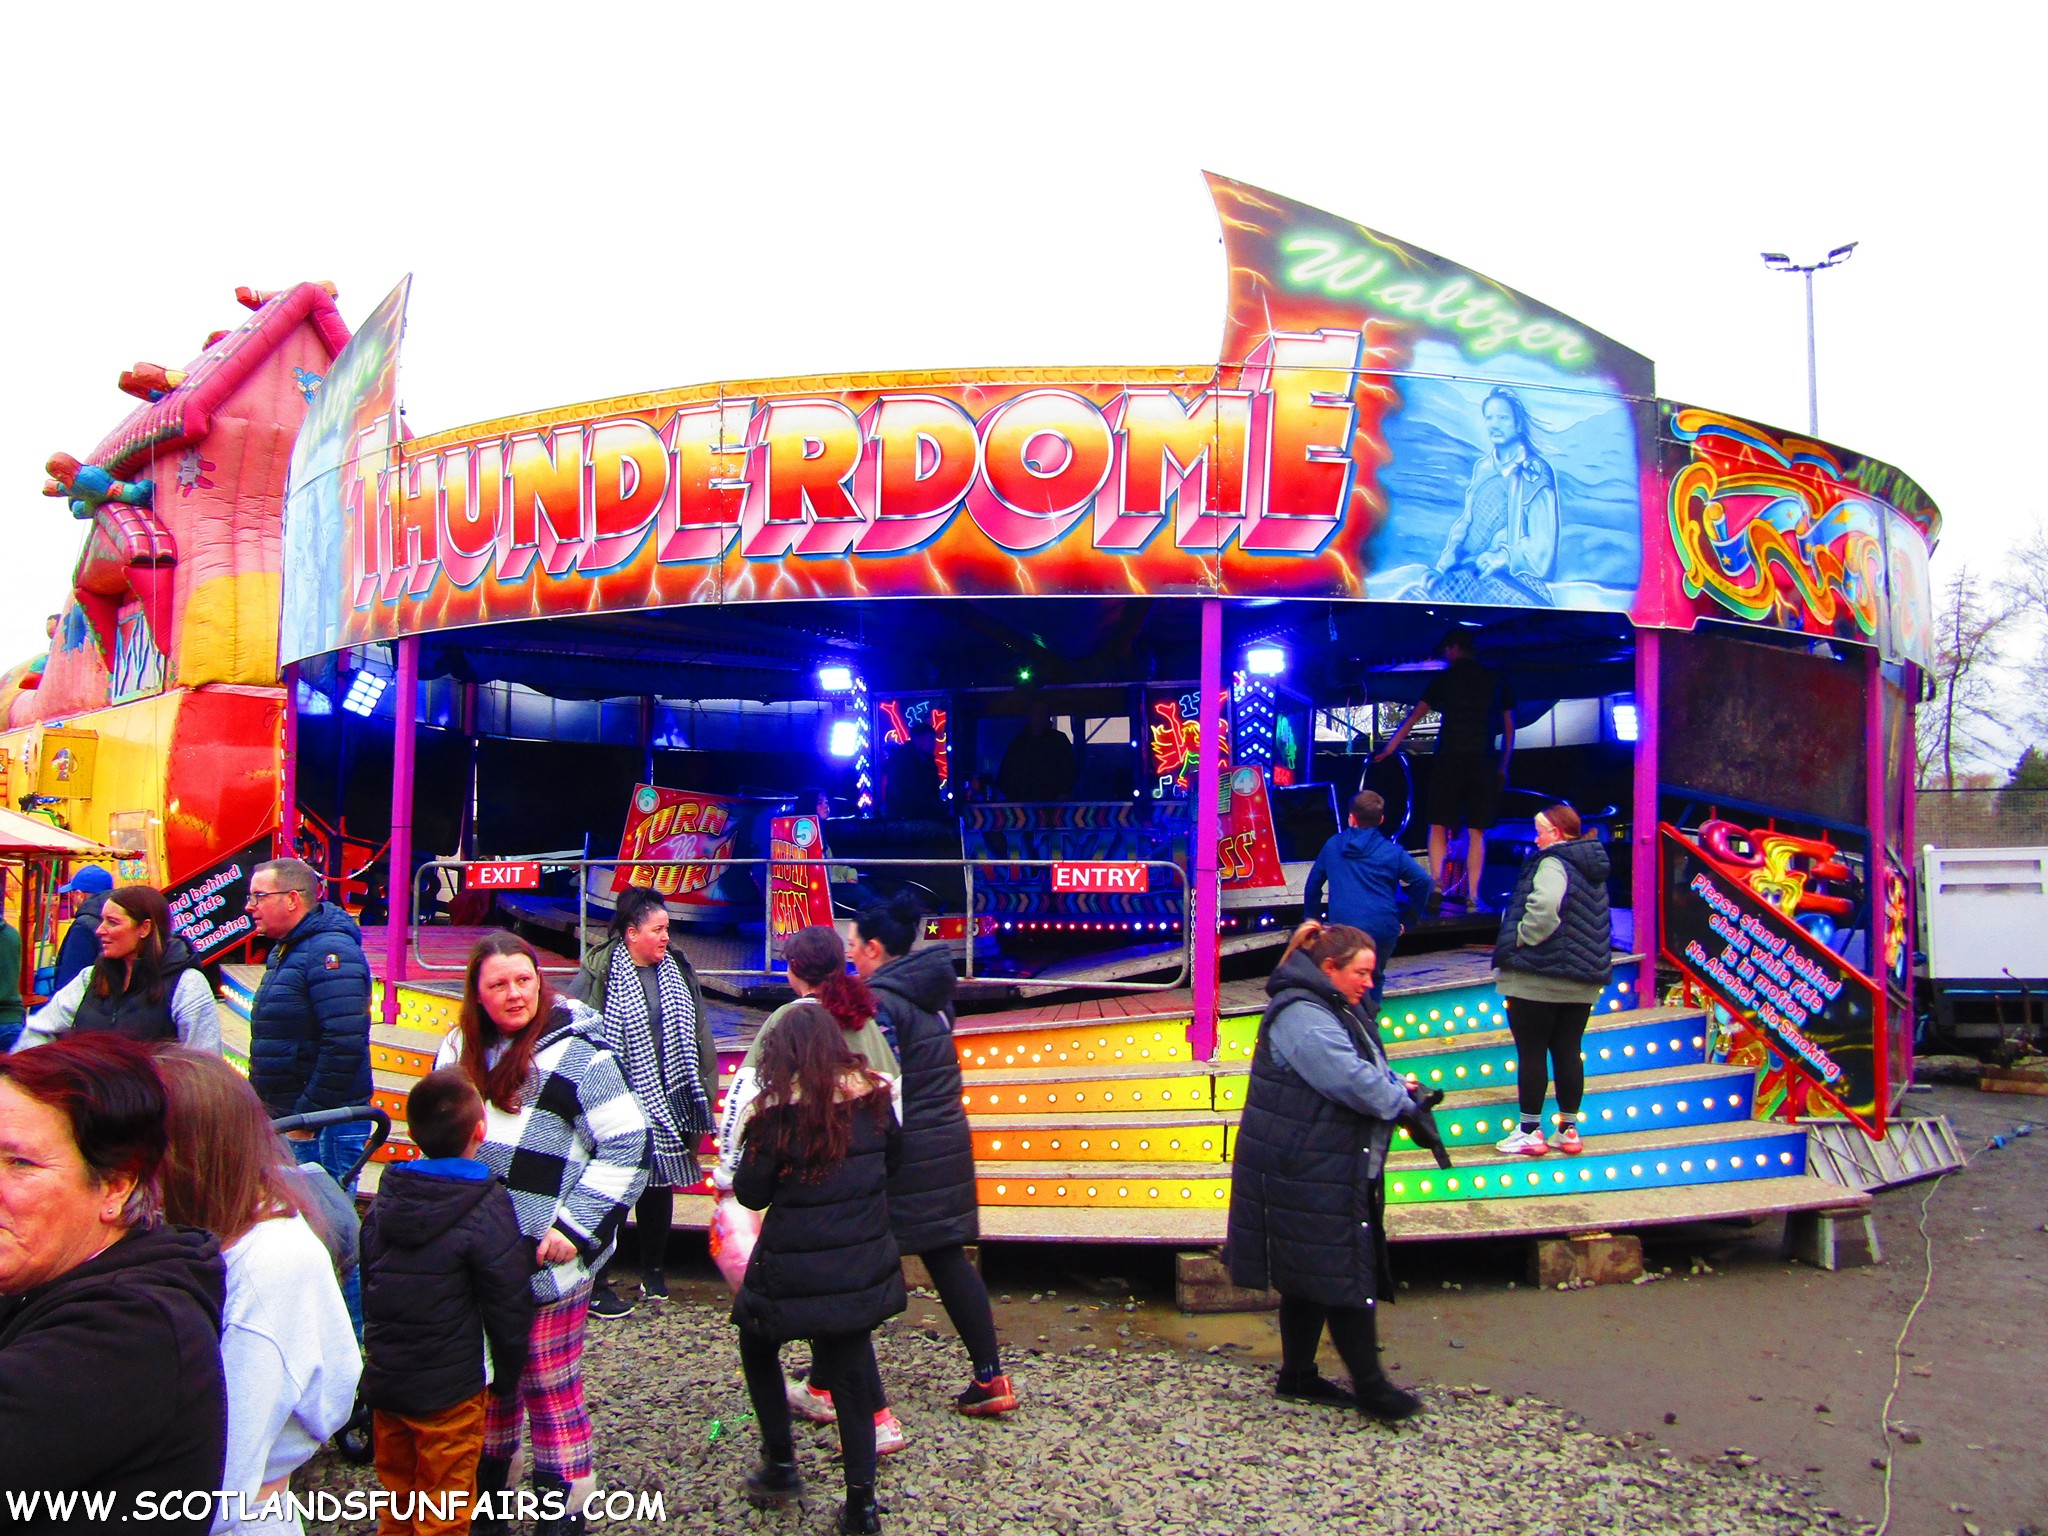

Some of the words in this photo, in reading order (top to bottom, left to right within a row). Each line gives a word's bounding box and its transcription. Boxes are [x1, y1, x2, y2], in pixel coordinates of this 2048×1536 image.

[1283, 236, 1584, 361] Waltzer
[346, 327, 1365, 609] THUNDERDOME
[1233, 766, 1254, 794] 4
[632, 803, 729, 860] TURN
[796, 818, 813, 847] 5
[190, 864, 242, 902] behind
[480, 866, 525, 885] EXIT
[1056, 867, 1141, 887] ENTRY
[194, 895, 226, 918] ride
[193, 915, 251, 953] Smoking
[1691, 872, 1740, 922] Please
[1739, 913, 1786, 956] stand
[1783, 945, 1842, 1000] behind
[1708, 913, 1751, 955] chain
[1750, 945, 1790, 987] while
[1789, 978, 1825, 1014] ride
[1721, 944, 1738, 967] is
[1737, 958, 1755, 981] in
[1753, 973, 1807, 1027] motion
[1685, 940, 1706, 965] No
[1703, 957, 1756, 1007] Alcohol
[1758, 1003, 1781, 1030] No
[1778, 1019, 1841, 1083] Smoking
